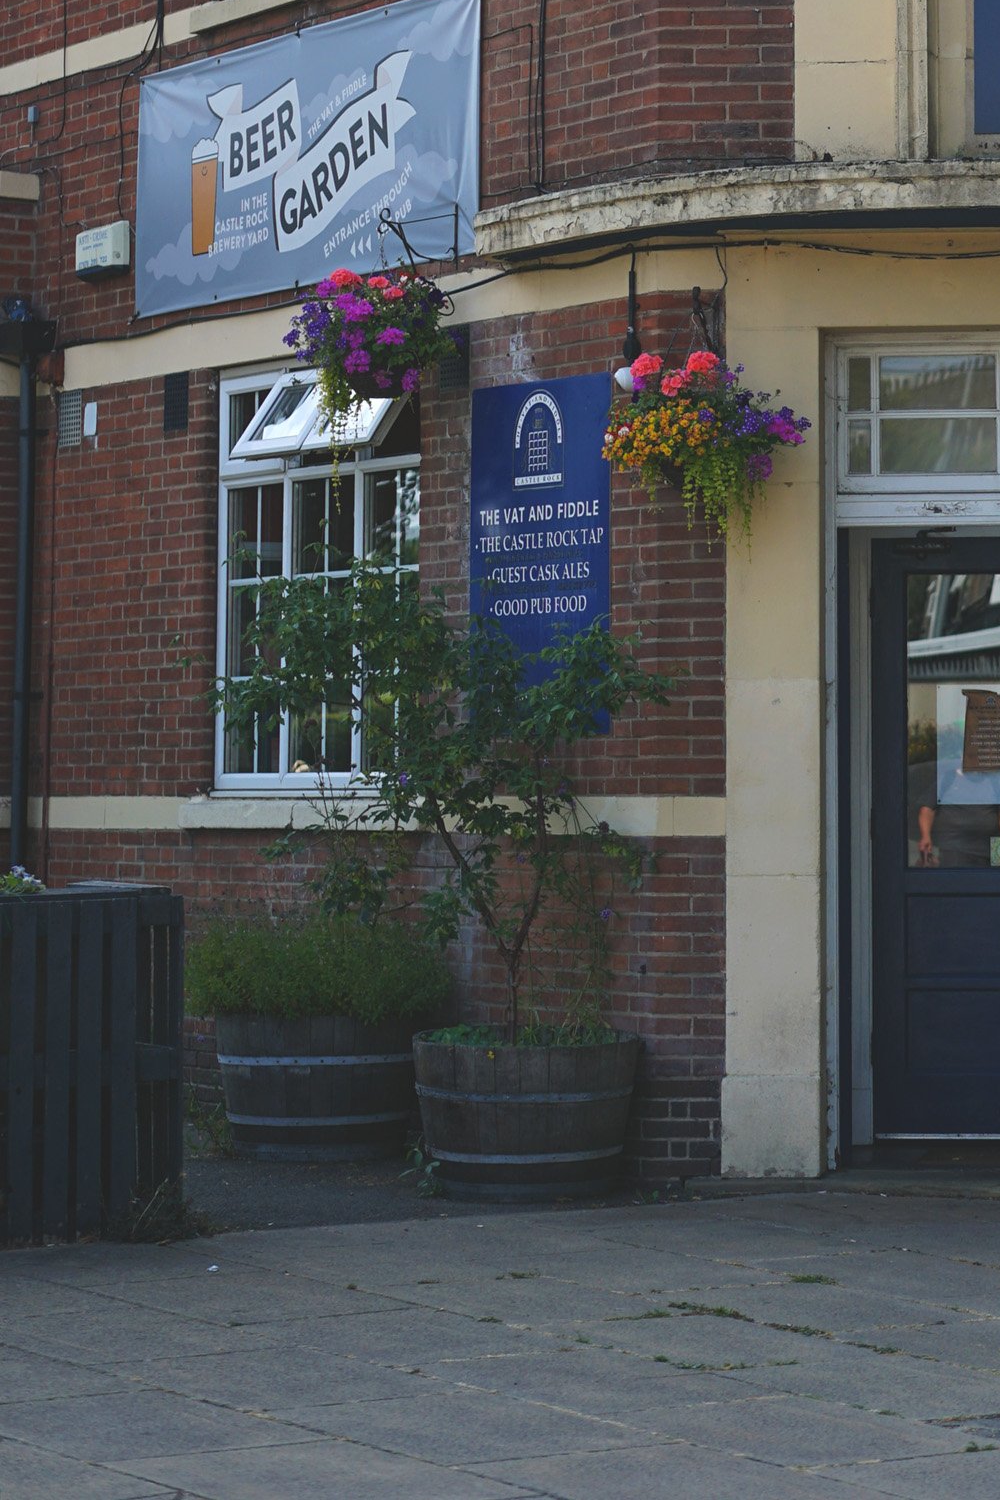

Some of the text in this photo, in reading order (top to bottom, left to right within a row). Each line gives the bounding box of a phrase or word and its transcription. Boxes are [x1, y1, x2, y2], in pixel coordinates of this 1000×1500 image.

[307, 74, 367, 139] THE VAT & FIDDLE
[229, 100, 297, 178] BEER
[280, 102, 389, 235] GARDEN
[240, 192, 268, 212] IN THE
[323, 161, 412, 258] ENTRANCE THROUGH
[394, 198, 412, 223] PUB
[215, 207, 269, 234] CASTLE ROCK
[208, 227, 269, 258] BREWERY YARD
[516, 474, 560, 485] CASTLE ROCK
[480, 499, 599, 526] THE VAT AND FIDDLE
[480, 527, 604, 553] THE CASTLE ROCK TAP
[492, 562, 590, 583] GUEST CASK ALES
[494, 595, 587, 616] GOOD PUB FOOD
